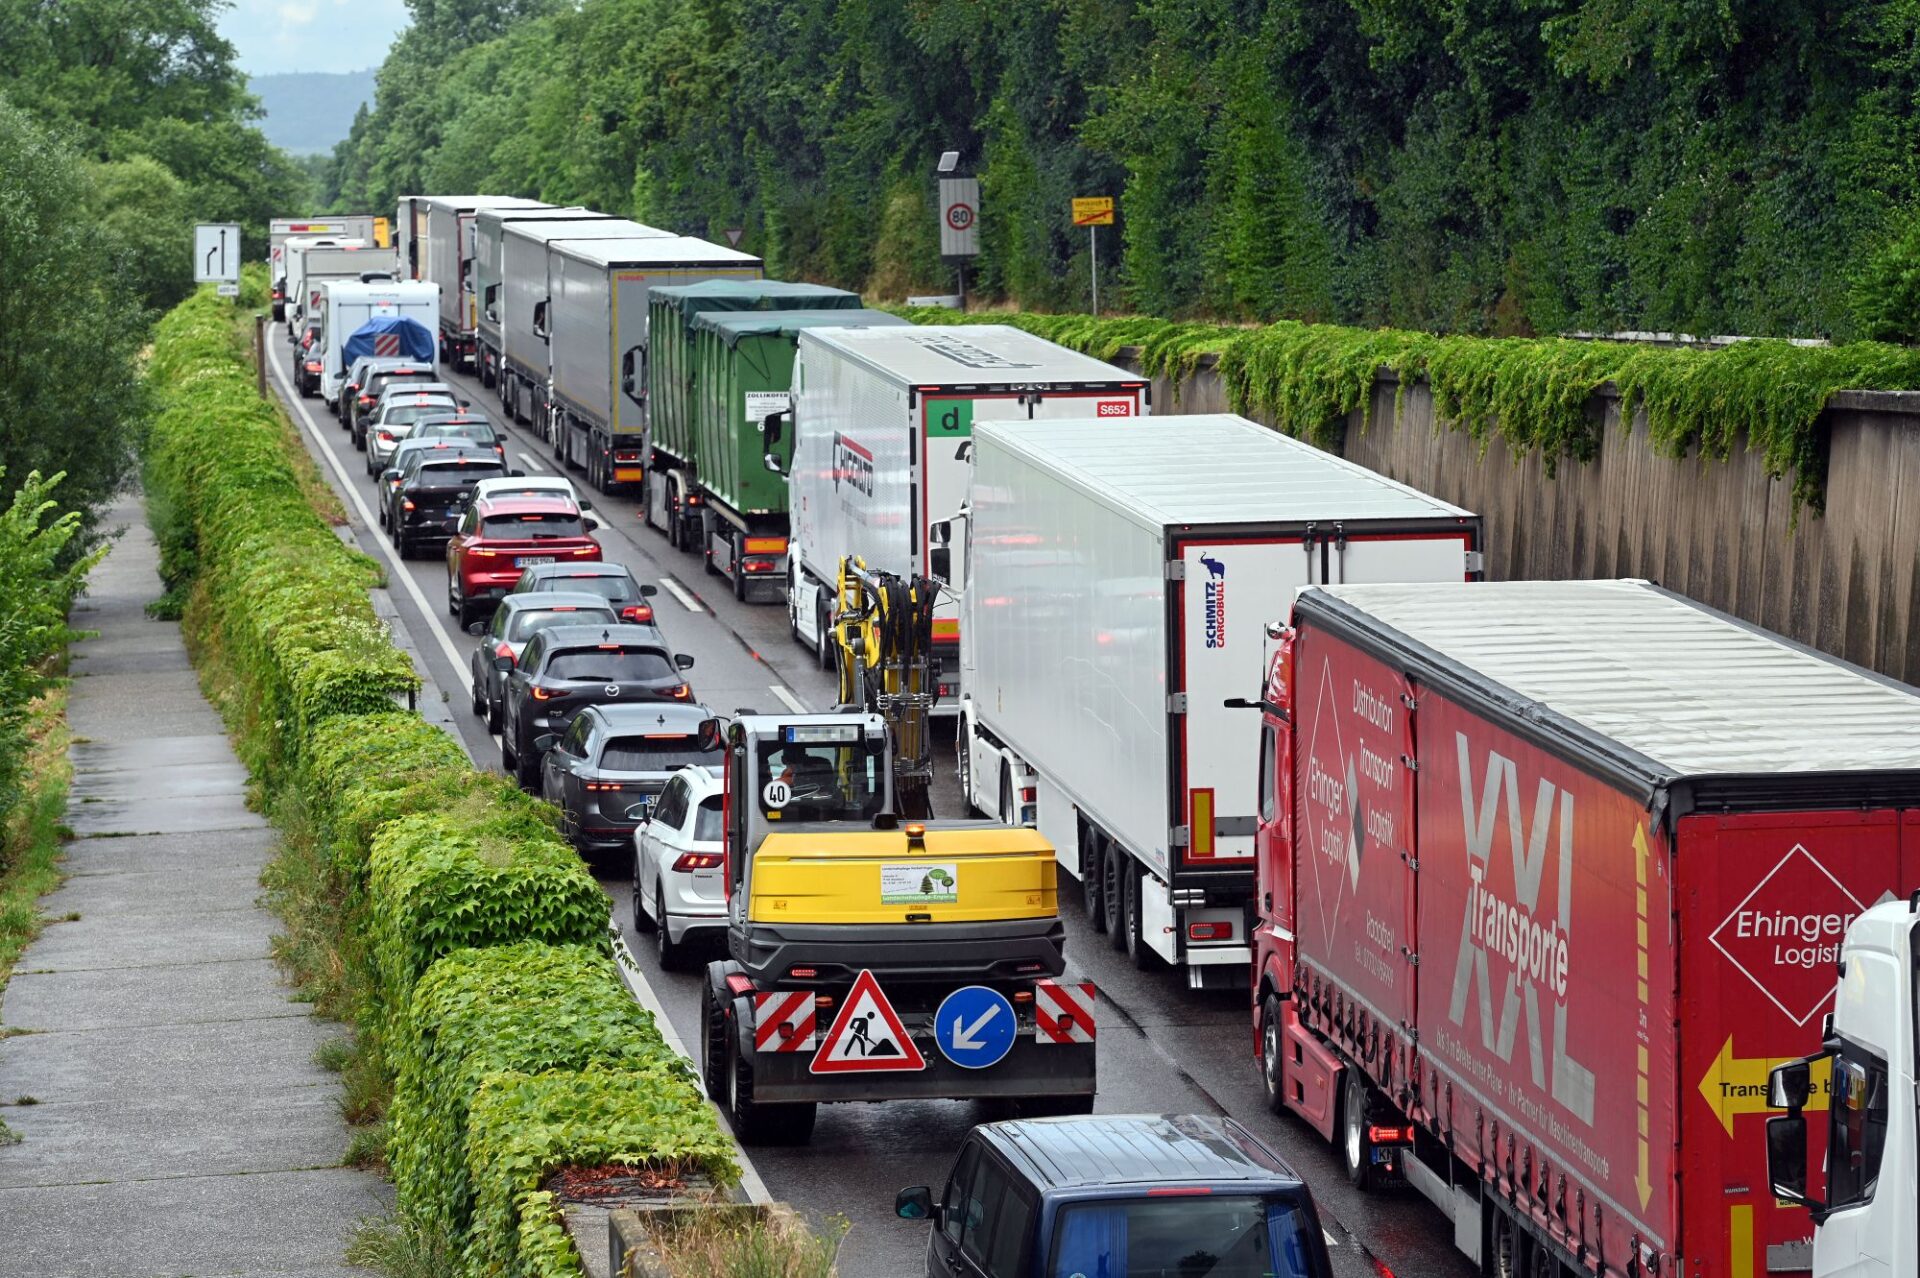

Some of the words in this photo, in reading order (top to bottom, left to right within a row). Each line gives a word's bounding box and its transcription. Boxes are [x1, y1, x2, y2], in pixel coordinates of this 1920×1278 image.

[951, 210, 969, 223] 80
[941, 407, 959, 430] d
[1100, 405, 1127, 415] S652
[1205, 582, 1216, 648] SCHMITZ
[1216, 581, 1224, 648] CARGOBULL
[1353, 679, 1393, 736] Distribution
[1311, 756, 1343, 822] Ehinger
[1360, 737, 1393, 791] Transport
[769, 785, 785, 803] 40
[1321, 818, 1344, 865] Logistik
[1367, 798, 1393, 849] Logistik
[1448, 730, 1596, 1128] XXL
[1469, 863, 1569, 997] Transporte
[1736, 910, 1856, 943] Ehinger
[1774, 943, 1840, 969] Logist
[1472, 1053, 1487, 1081] unter
[1487, 1063, 1502, 1096] Plane
[1517, 1086, 1538, 1123] Partner
[1550, 1110, 1609, 1181] Maschinentransporte
